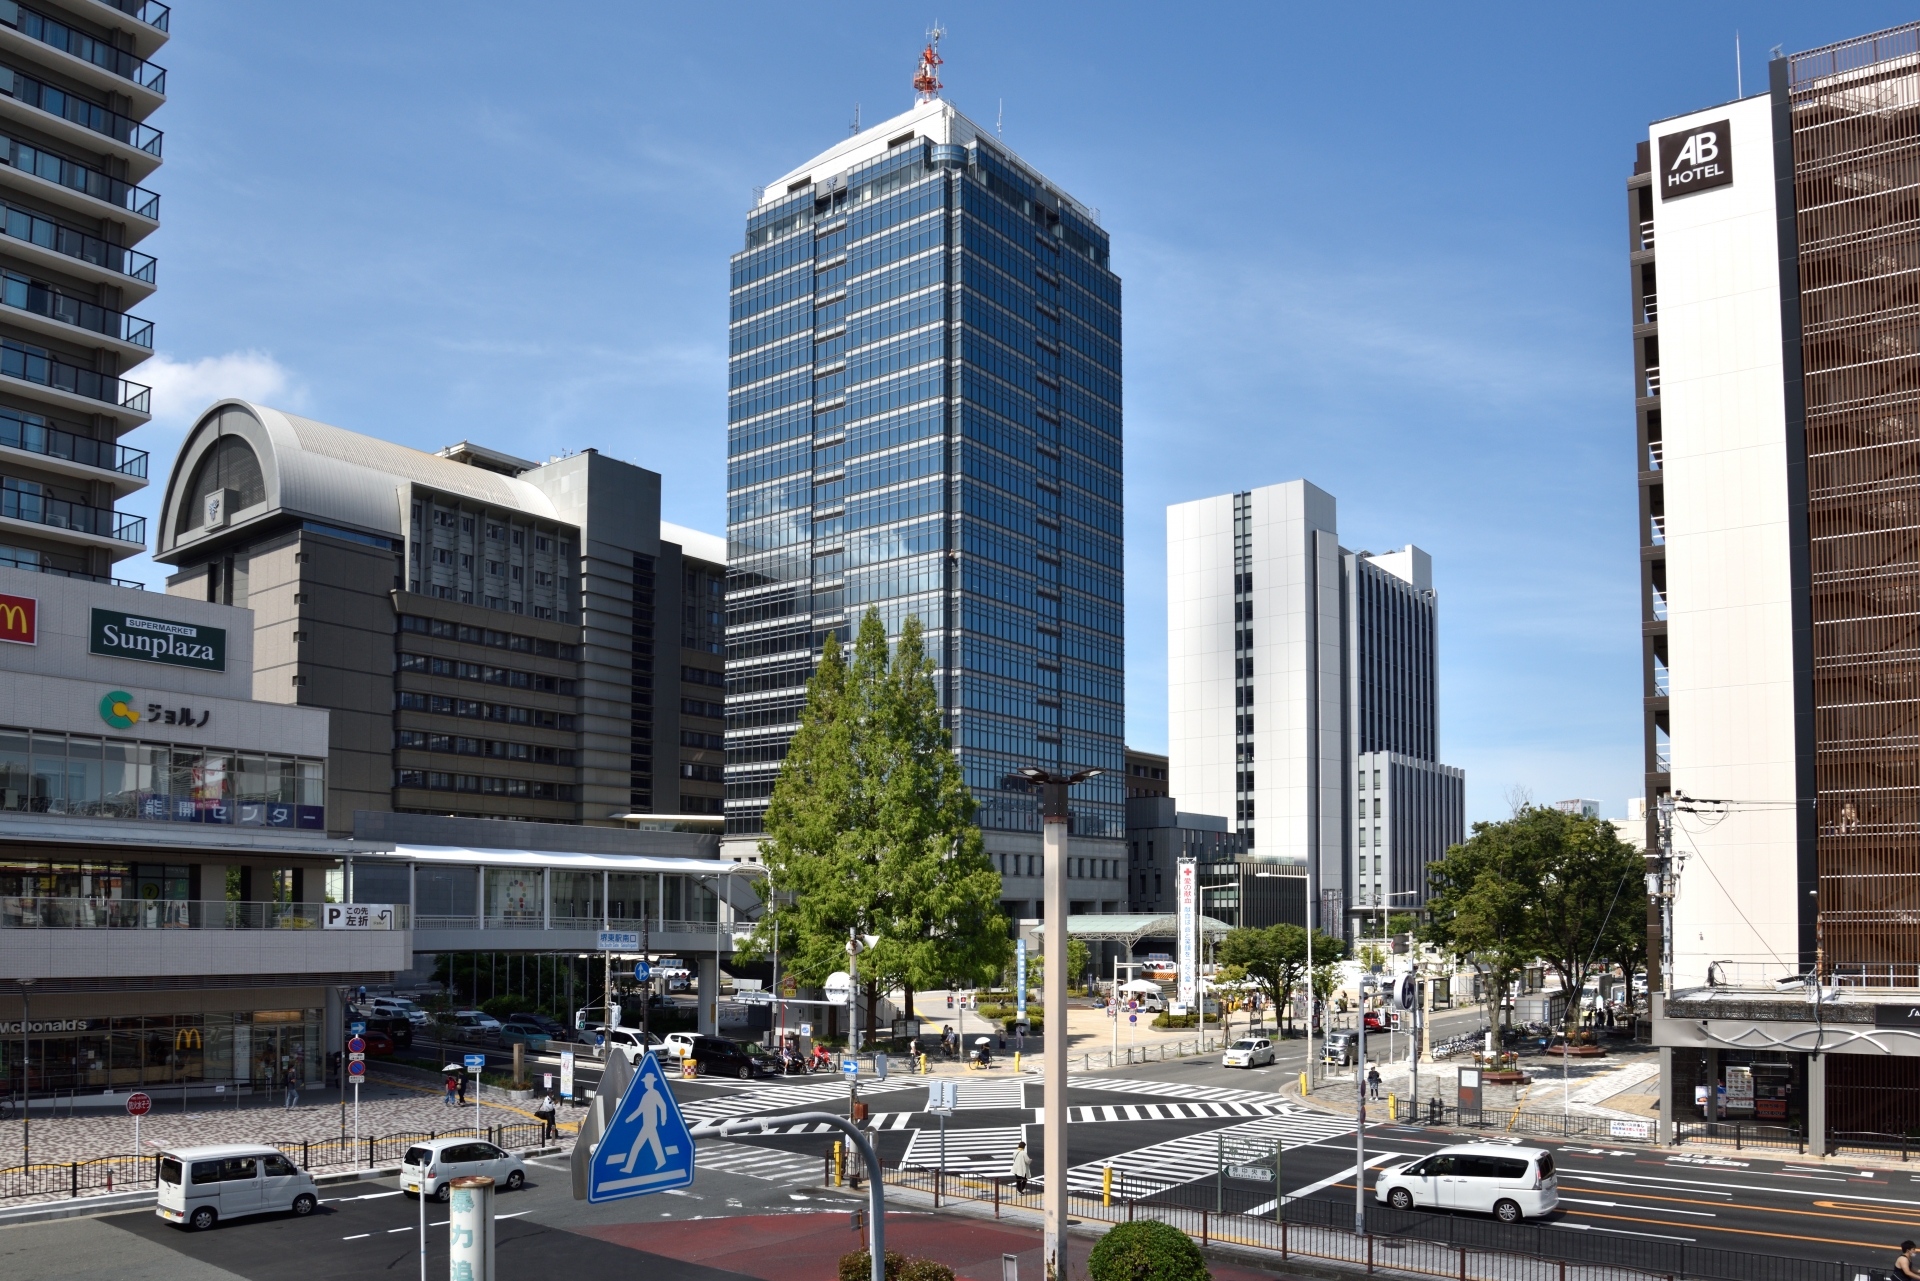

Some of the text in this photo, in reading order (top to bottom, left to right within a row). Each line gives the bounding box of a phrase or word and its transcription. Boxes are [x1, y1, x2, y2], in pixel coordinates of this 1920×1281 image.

[1671, 131, 1718, 171] AB
[1668, 163, 1724, 187] HOTEL
[129, 619, 194, 636] SUPERMARKET
[103, 624, 215, 661] Sunplaza
[148, 703, 210, 728] ジョルノ
[145, 799, 316, 823] 能開センター
[1184, 877, 1192, 904] 愛の献血
[328, 908, 341, 925] P
[346, 907, 368, 915] この先
[346, 916, 368, 926] 左折
[600, 933, 637, 943] 堺東駅南口
